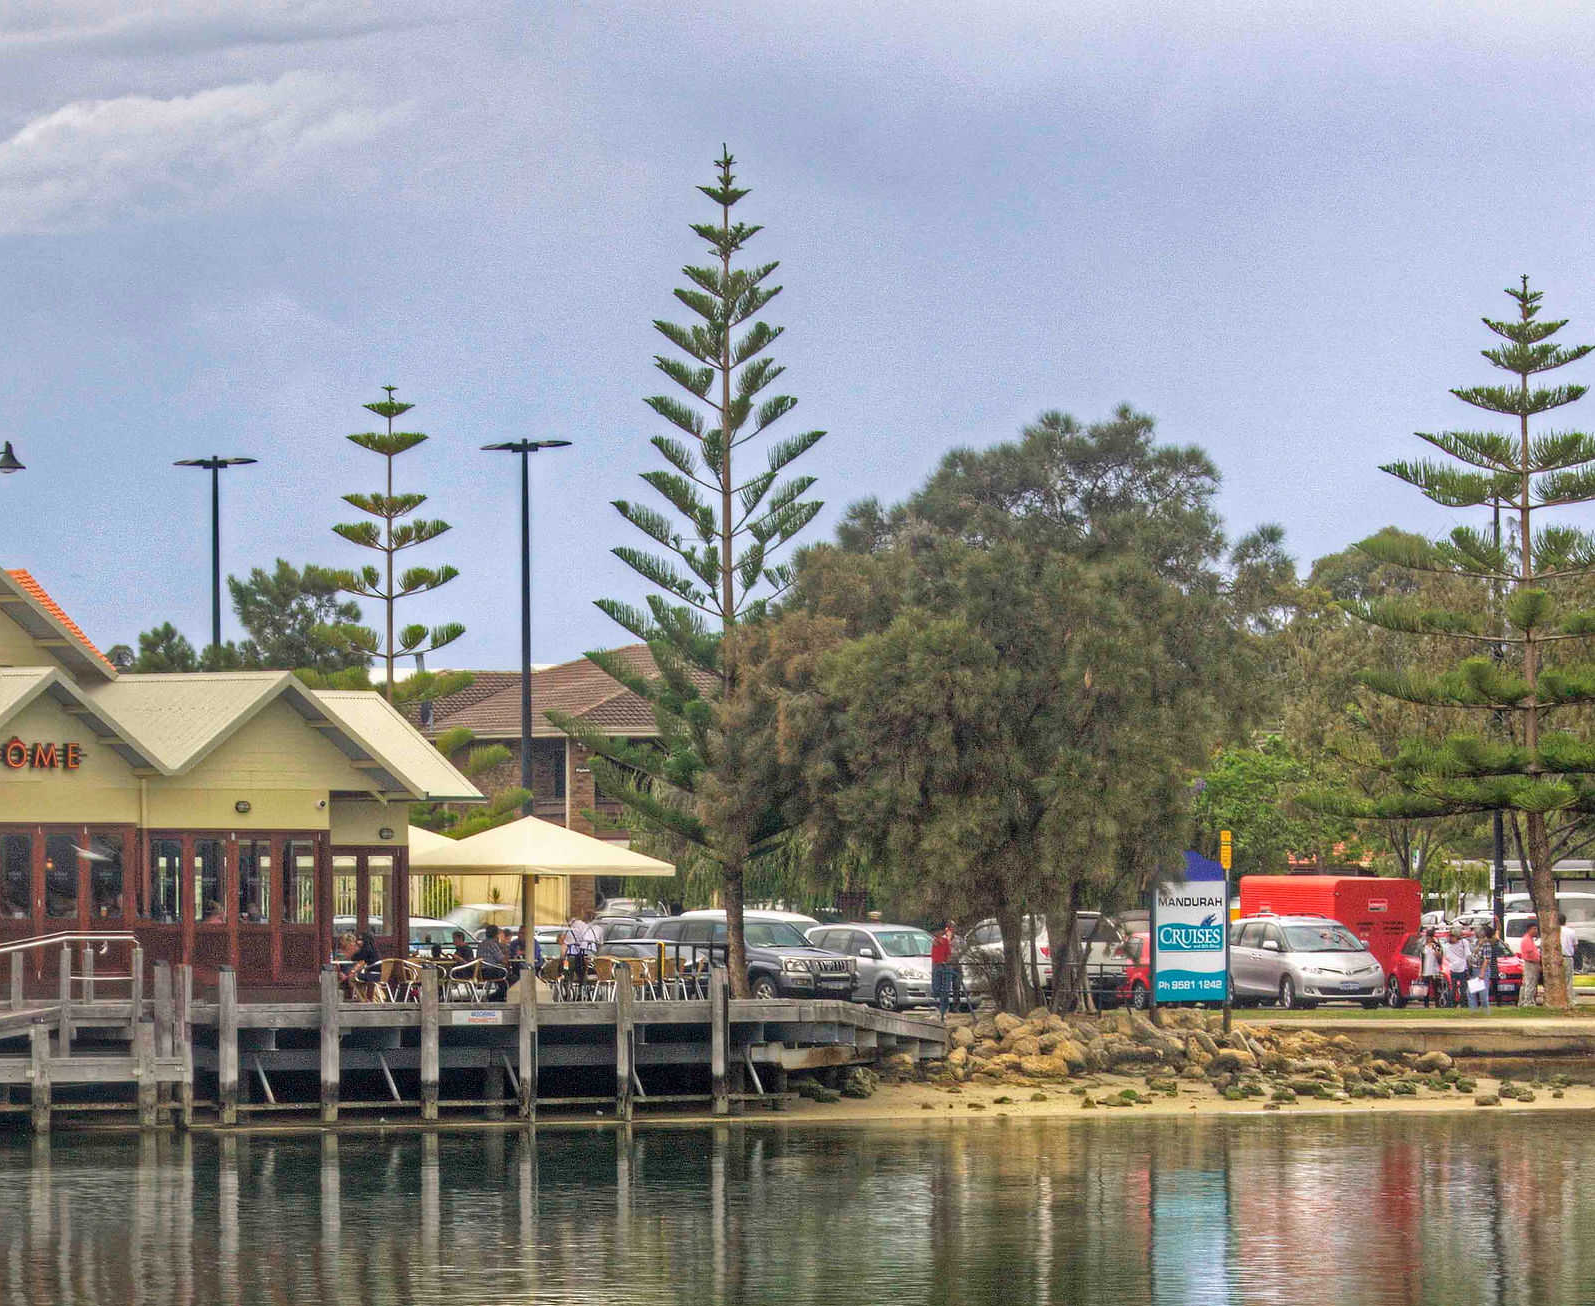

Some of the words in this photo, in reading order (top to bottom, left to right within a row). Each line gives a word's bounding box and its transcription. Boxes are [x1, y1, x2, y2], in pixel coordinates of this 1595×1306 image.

[1158, 897, 1223, 907] MANDURAH
[1160, 927, 1221, 948] CRUISES
[1198, 980, 1222, 989] 1242
